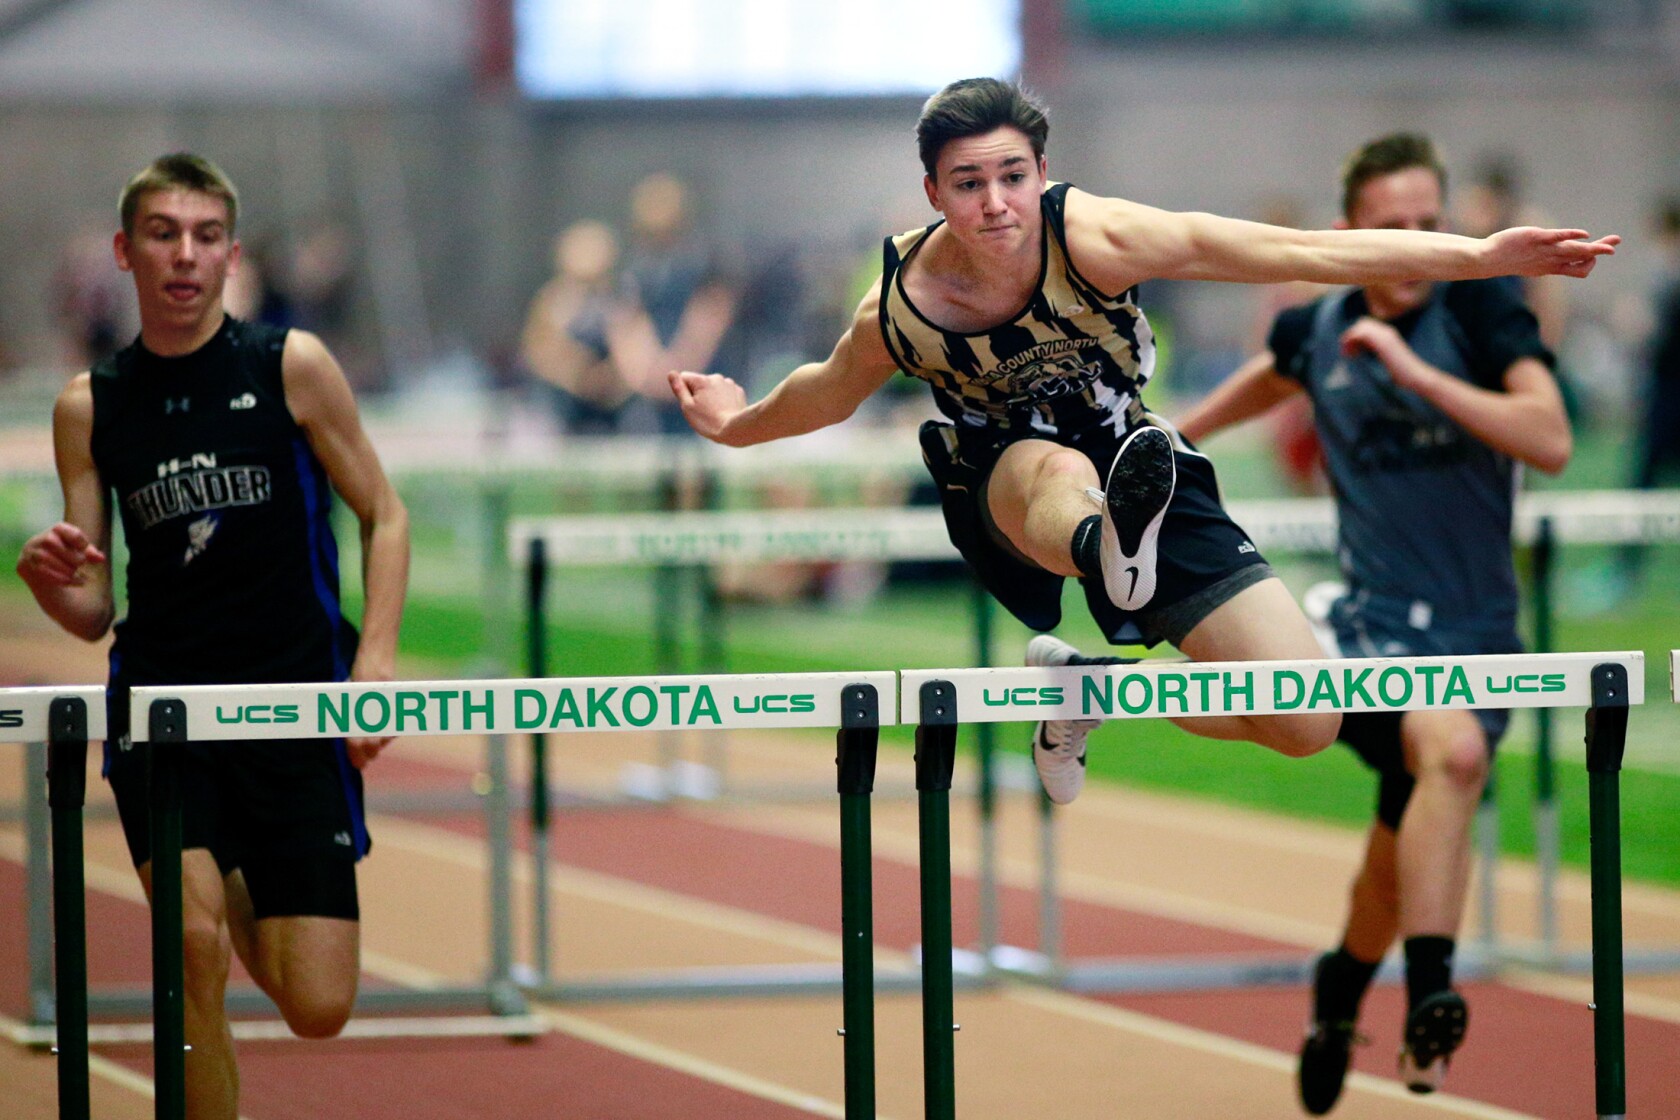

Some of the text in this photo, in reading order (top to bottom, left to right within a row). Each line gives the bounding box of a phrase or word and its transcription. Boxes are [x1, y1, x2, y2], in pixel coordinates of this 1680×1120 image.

[999, 342, 1052, 376] COUNTY
[128, 464, 272, 530] THUNDER
[216, 684, 816, 733] UCS NORTH DAKOTA UCS
[983, 665, 1566, 715] UCS NORTH DAKOTA UCS
